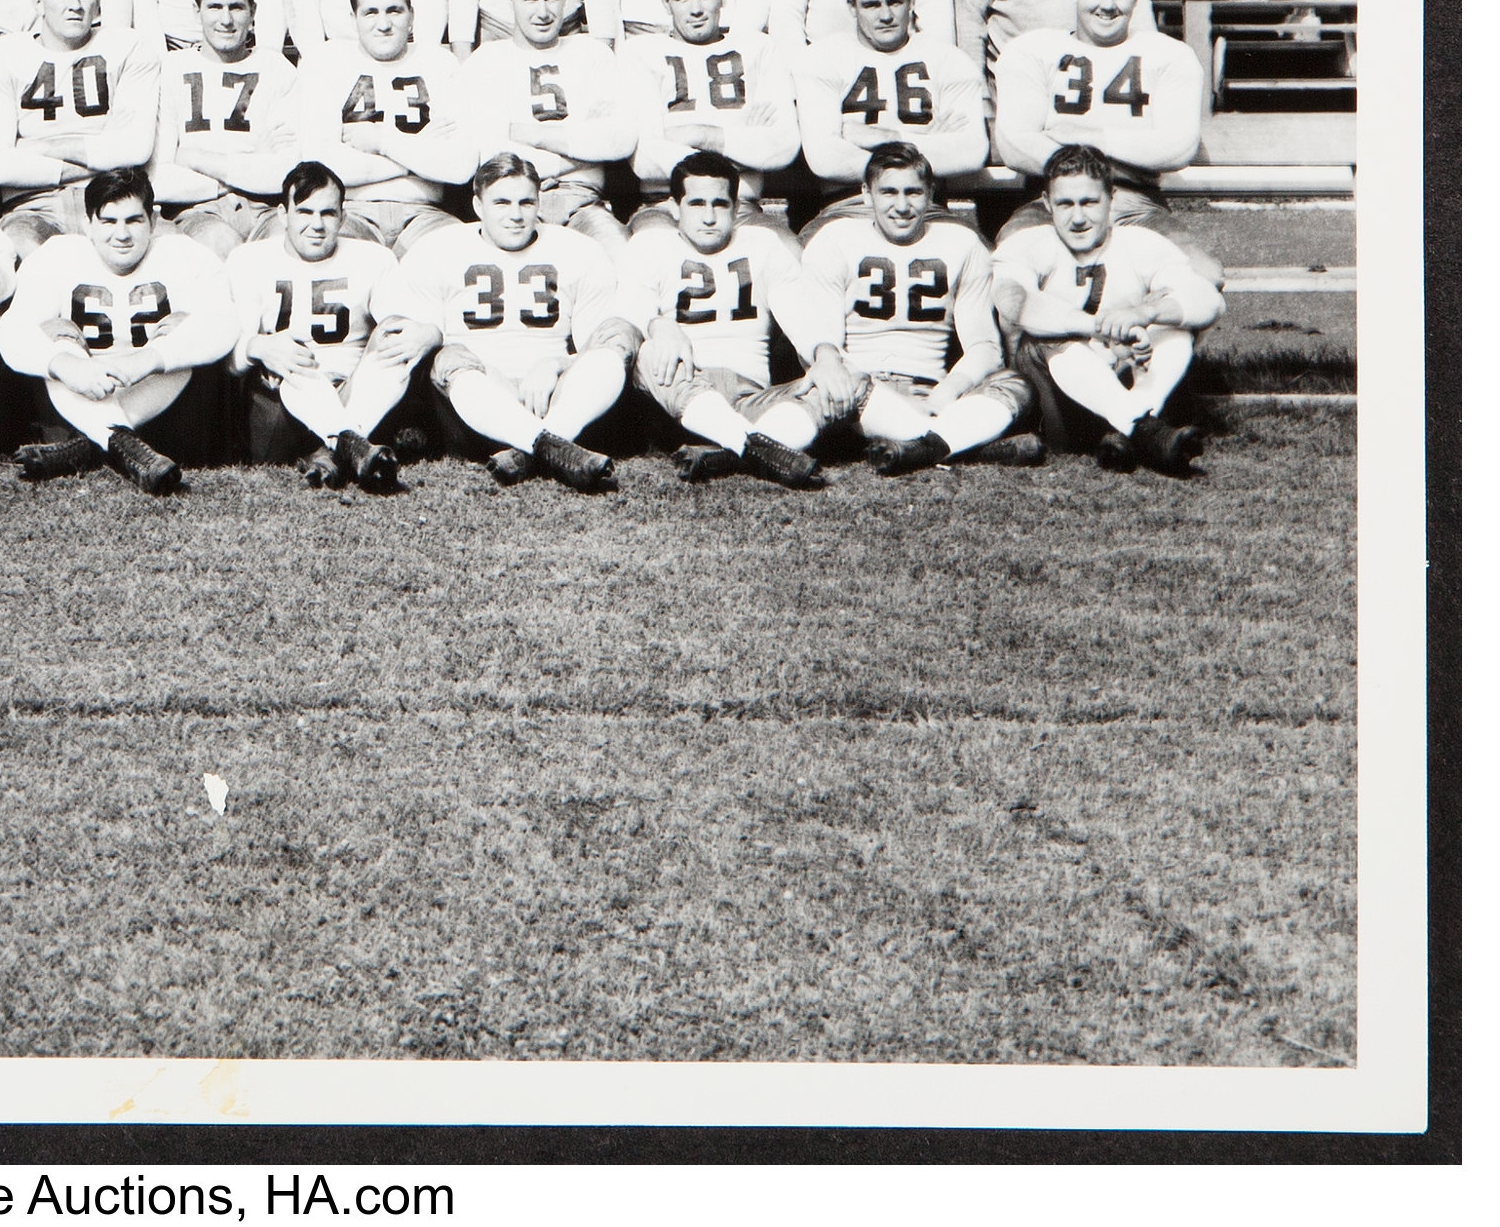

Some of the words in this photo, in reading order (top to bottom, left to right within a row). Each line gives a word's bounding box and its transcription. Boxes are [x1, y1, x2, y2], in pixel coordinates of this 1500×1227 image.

[20, 55, 109, 121] 40
[183, 72, 260, 132] 17
[341, 75, 431, 134] 43
[530, 64, 568, 121] 5
[665, 51, 747, 110] 18
[842, 62, 933, 124] 46
[1054, 55, 1150, 117] 34
[70, 282, 171, 349] 62
[275, 277, 350, 345] 15
[463, 263, 560, 330] 33
[675, 257, 758, 324] 21
[853, 256, 949, 322] 32
[1075, 263, 1106, 315] 7
